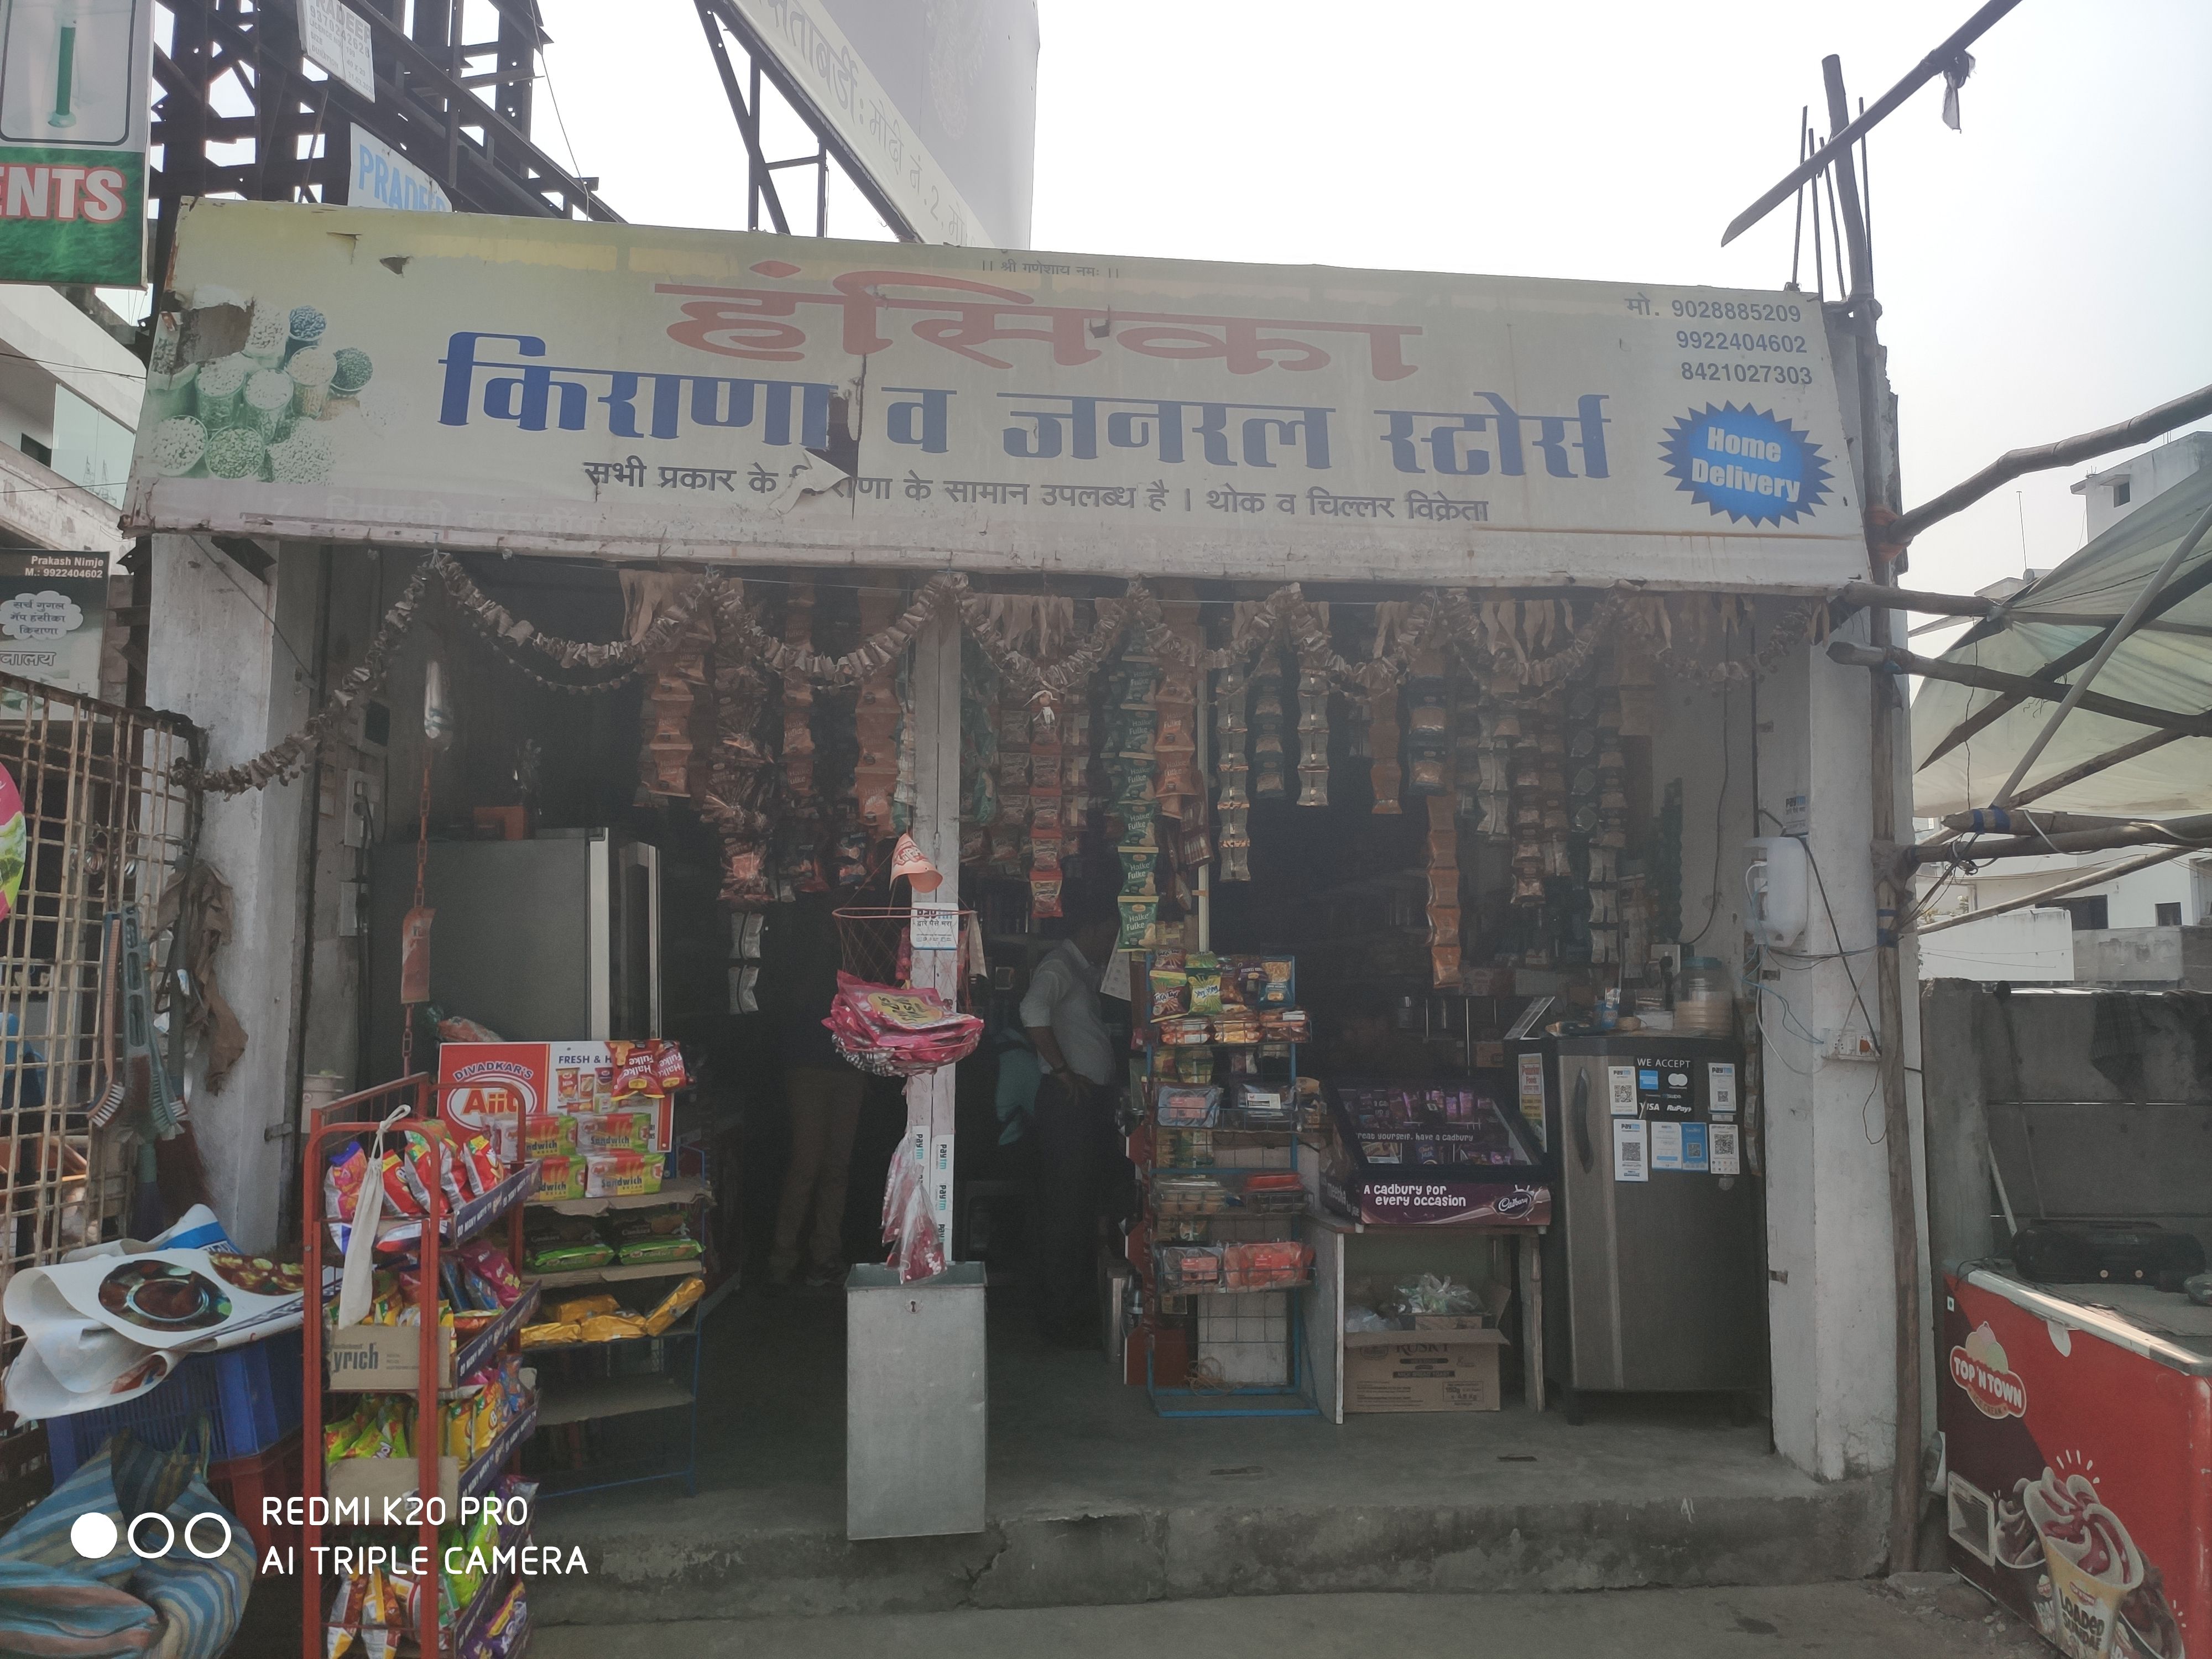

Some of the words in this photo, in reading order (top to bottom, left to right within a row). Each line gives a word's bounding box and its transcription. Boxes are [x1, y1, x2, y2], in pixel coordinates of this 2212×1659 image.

[0, 166, 124, 222] NTS
[1000, 260, 1018, 273] श्री
[1021, 261, 1071, 277] गणेशाय
[1671, 299, 1801, 324] 9028885209
[655, 260, 1423, 381] हंसिका
[1676, 330, 1807, 354] 9922404602
[1681, 362, 1813, 386] 8421027303
[881, 386, 958, 453] व
[996, 392, 1335, 469] जनरल
[1374, 391, 1611, 478] स्टोर्स
[1707, 426, 1782, 463] Home
[1691, 458, 1801, 503] Delivery
[583, 455, 647, 488] सभी
[658, 466, 737, 493] प्रकार
[747, 461, 779, 494] के
[903, 469, 933, 501] के
[943, 479, 1029, 505] सामान
[1041, 483, 1136, 509] उपलब्ध
[1146, 479, 1170, 512] है
[1206, 482, 1266, 514] थोक
[1277, 494, 1296, 515] व
[1306, 486, 1395, 519] चिल्लर
[1407, 489, 1489, 523] विक्रेता
[31, 555, 71, 566] Prakash
[74, 557, 104, 568] Nimje
[43, 568, 103, 578] 9922404602
[19, 624, 58, 635] किराणा
[1130, 863, 1151, 872] Halke
[1128, 872, 1146, 880] Fulke
[1129, 913, 1149, 922] Halke
[1126, 922, 1145, 931] Fulke
[559, 1055, 590, 1064] FRESH
[628, 1055, 654, 1065] Fulke
[659, 1052, 682, 1067] Fulke
[1637, 1057, 1652, 1066] WE
[1655, 1059, 1691, 1068] ACCEPT
[453, 1061, 534, 1082] DIVADKAR'S
[623, 1065, 651, 1077] Halke
[1666, 1104, 1691, 1113] RuPay
[526, 1141, 557, 1151] ndwich
[539, 1182, 567, 1191] dwich
[601, 1177, 643, 1187] Sandwich
[1364, 1185, 1371, 1194] A
[1426, 1185, 1447, 1195] for
[1375, 1196, 1410, 1207] every
[1413, 1194, 1467, 1207] occasion
[1498, 1196, 1528, 1212] Cadbury
[1954, 1356, 1975, 1383] TOP
[1987, 1374, 2022, 1408] TOWN
